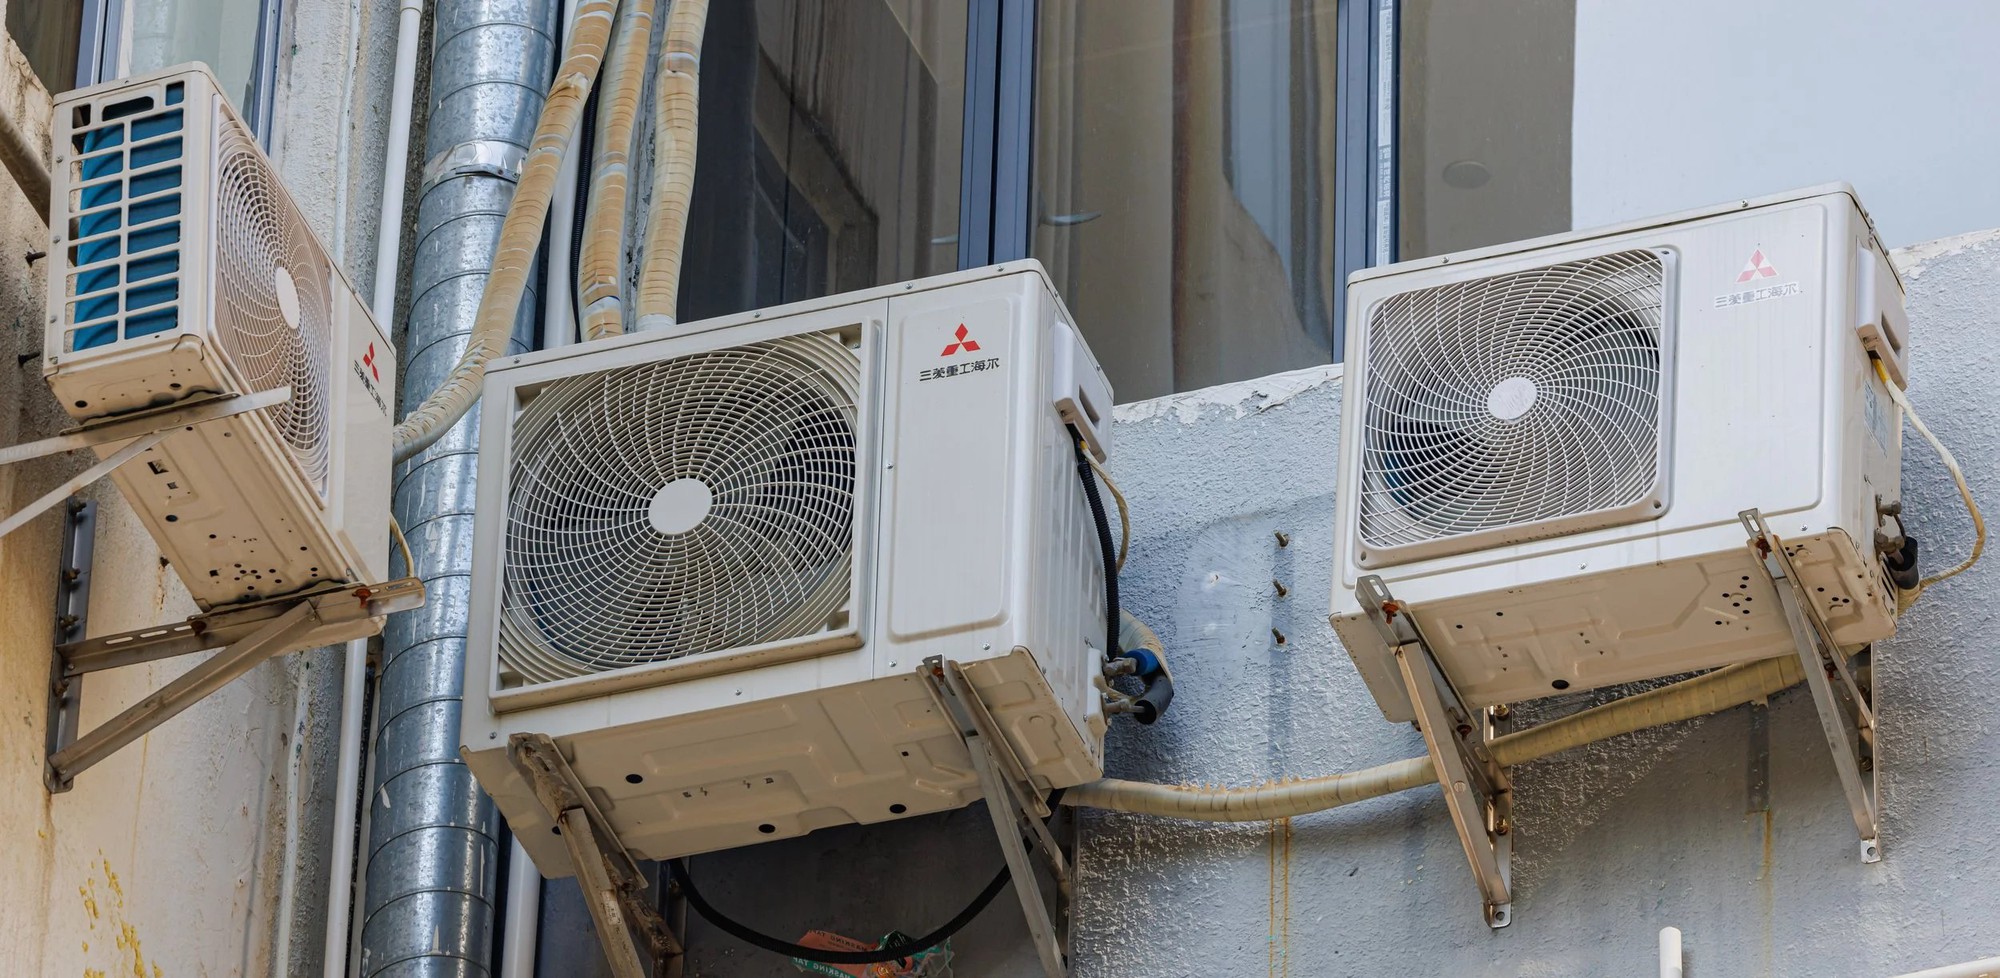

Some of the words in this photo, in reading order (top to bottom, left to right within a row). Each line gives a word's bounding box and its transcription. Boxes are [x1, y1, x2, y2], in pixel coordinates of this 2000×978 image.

[1715, 283, 1797, 308] 三菱重工海尔
[919, 357, 1000, 382] 三菱重工海尔
